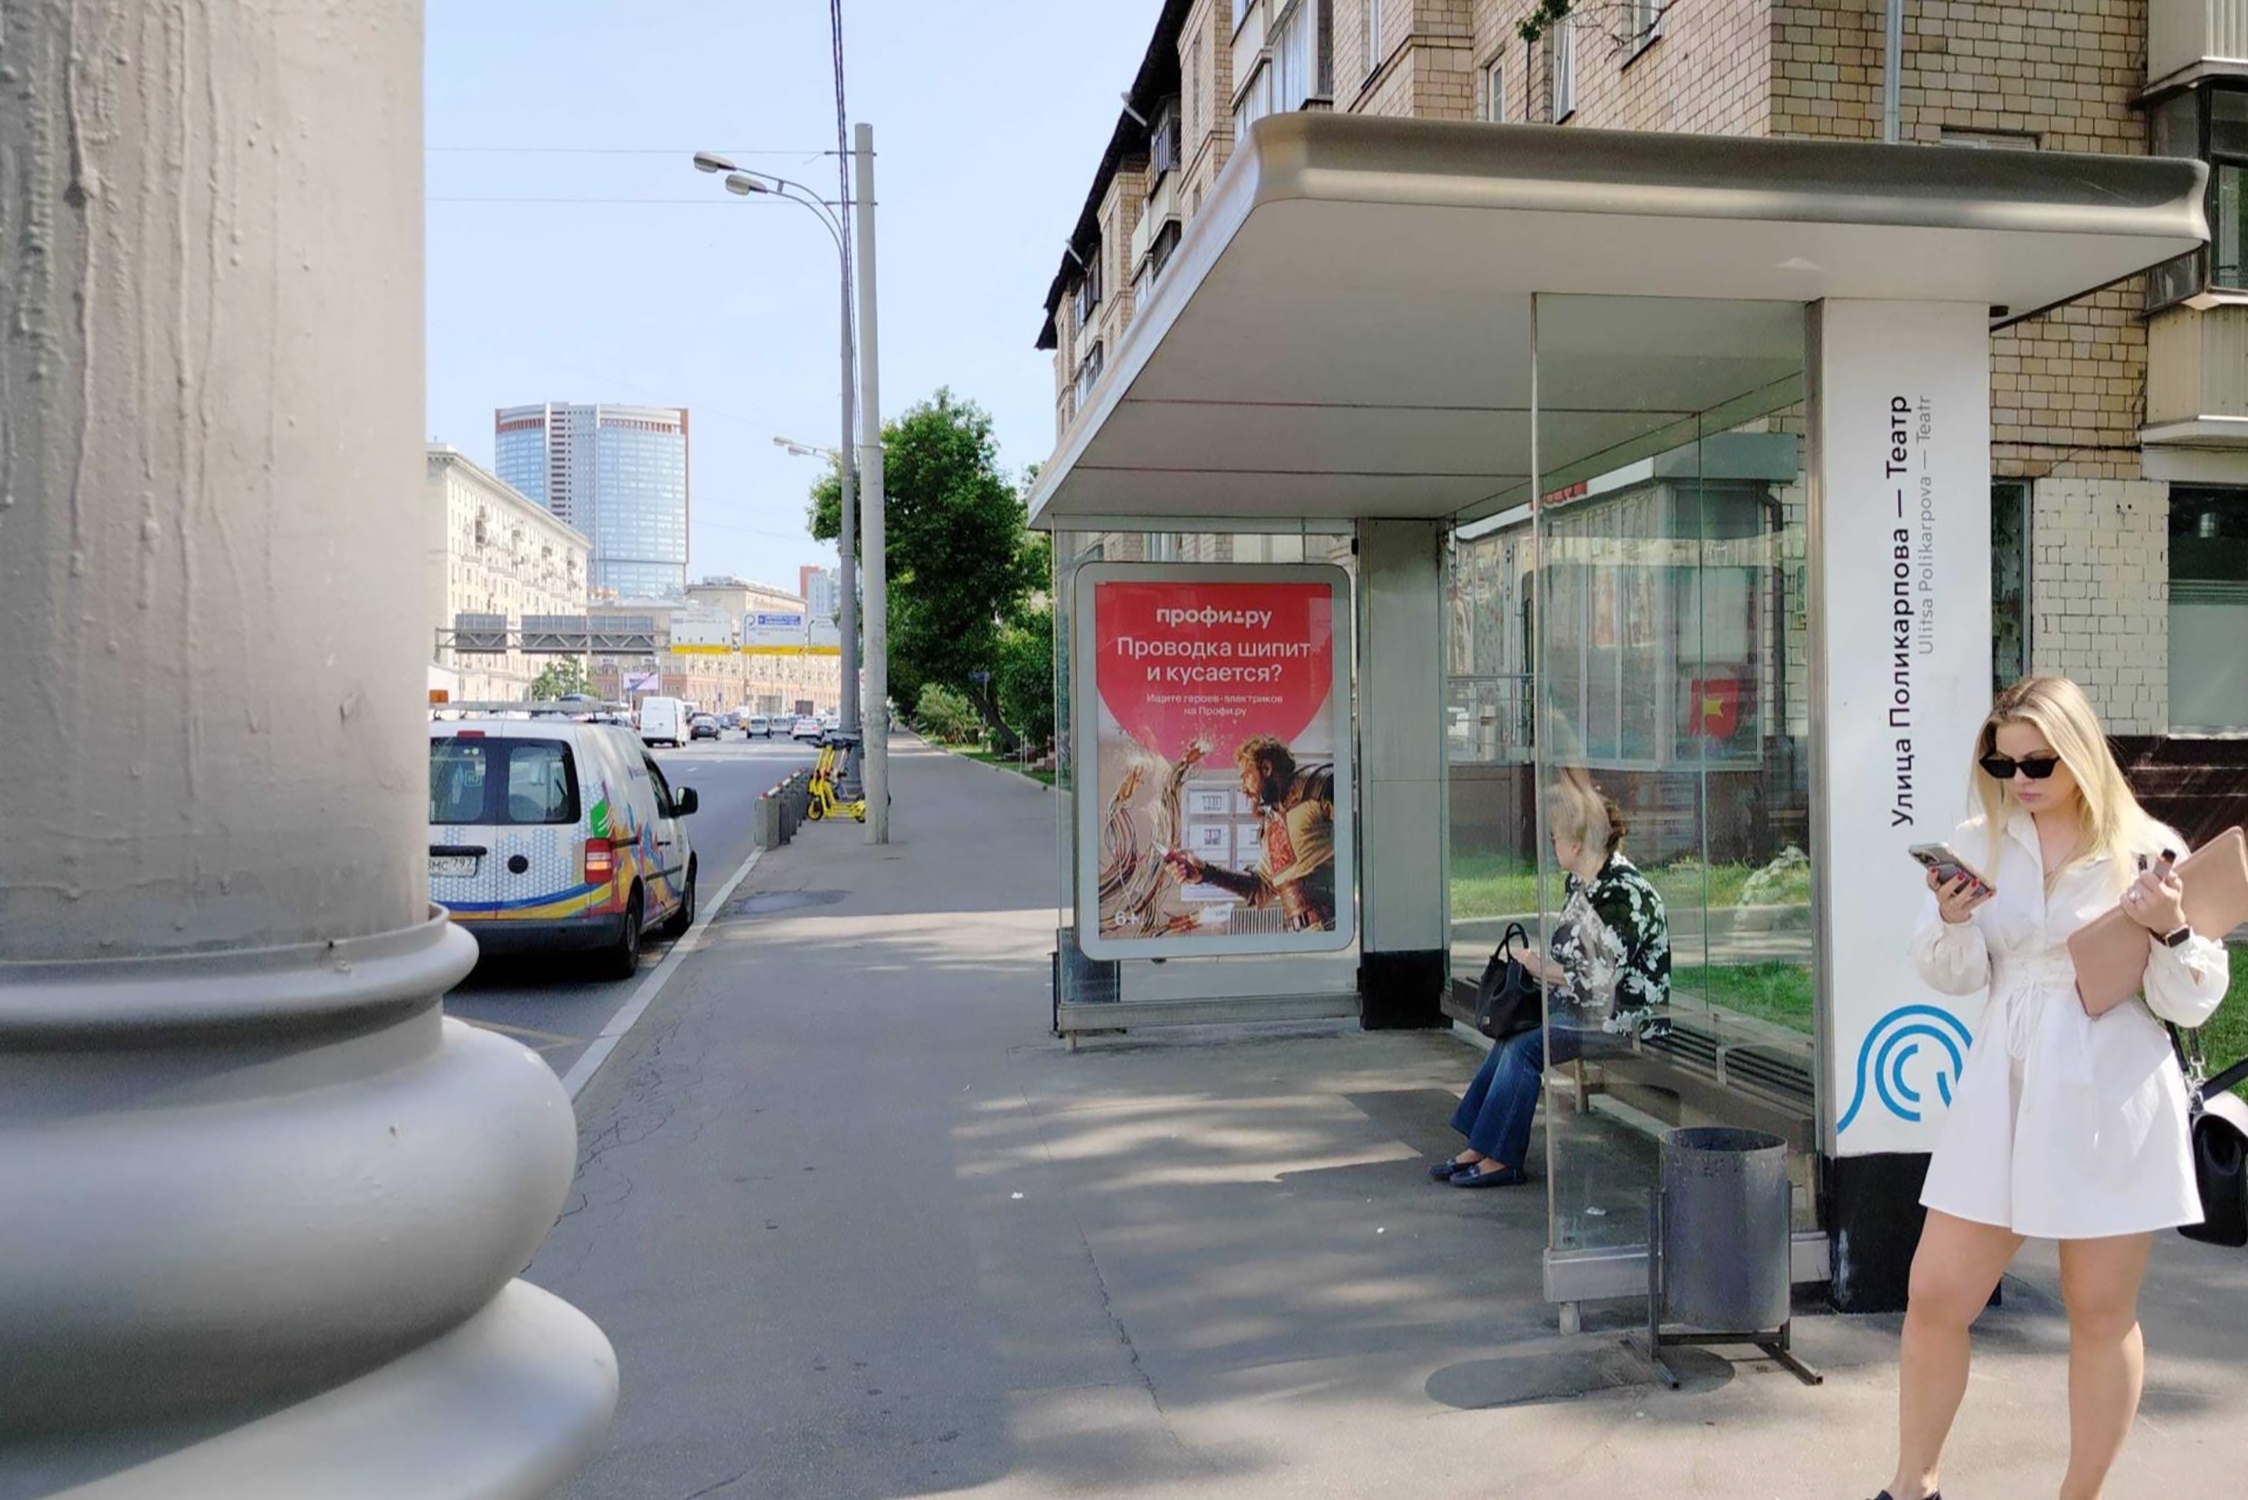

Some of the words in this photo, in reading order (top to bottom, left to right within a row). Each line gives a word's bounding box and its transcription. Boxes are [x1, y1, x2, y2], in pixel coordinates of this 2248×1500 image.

[1886, 395, 1912, 479] Театр
[1916, 395, 1932, 444] Teatr
[1918, 476, 1935, 591] Polikarpova
[1117, 636, 1232, 660] Проводка
[1237, 642, 1311, 658] шипит
[1889, 528, 1915, 727] Поликарпова
[1918, 598, 1934, 655] Ulitsa
[1146, 665, 1161, 683] и
[1166, 663, 1283, 686] кусается?
[1146, 692, 1183, 705] Ищите
[1184, 707, 1197, 716] на
[1199, 704, 1247, 718] Профи.ру
[1891, 738, 1915, 827] Улица
[1114, 910, 1139, 927] 6+
